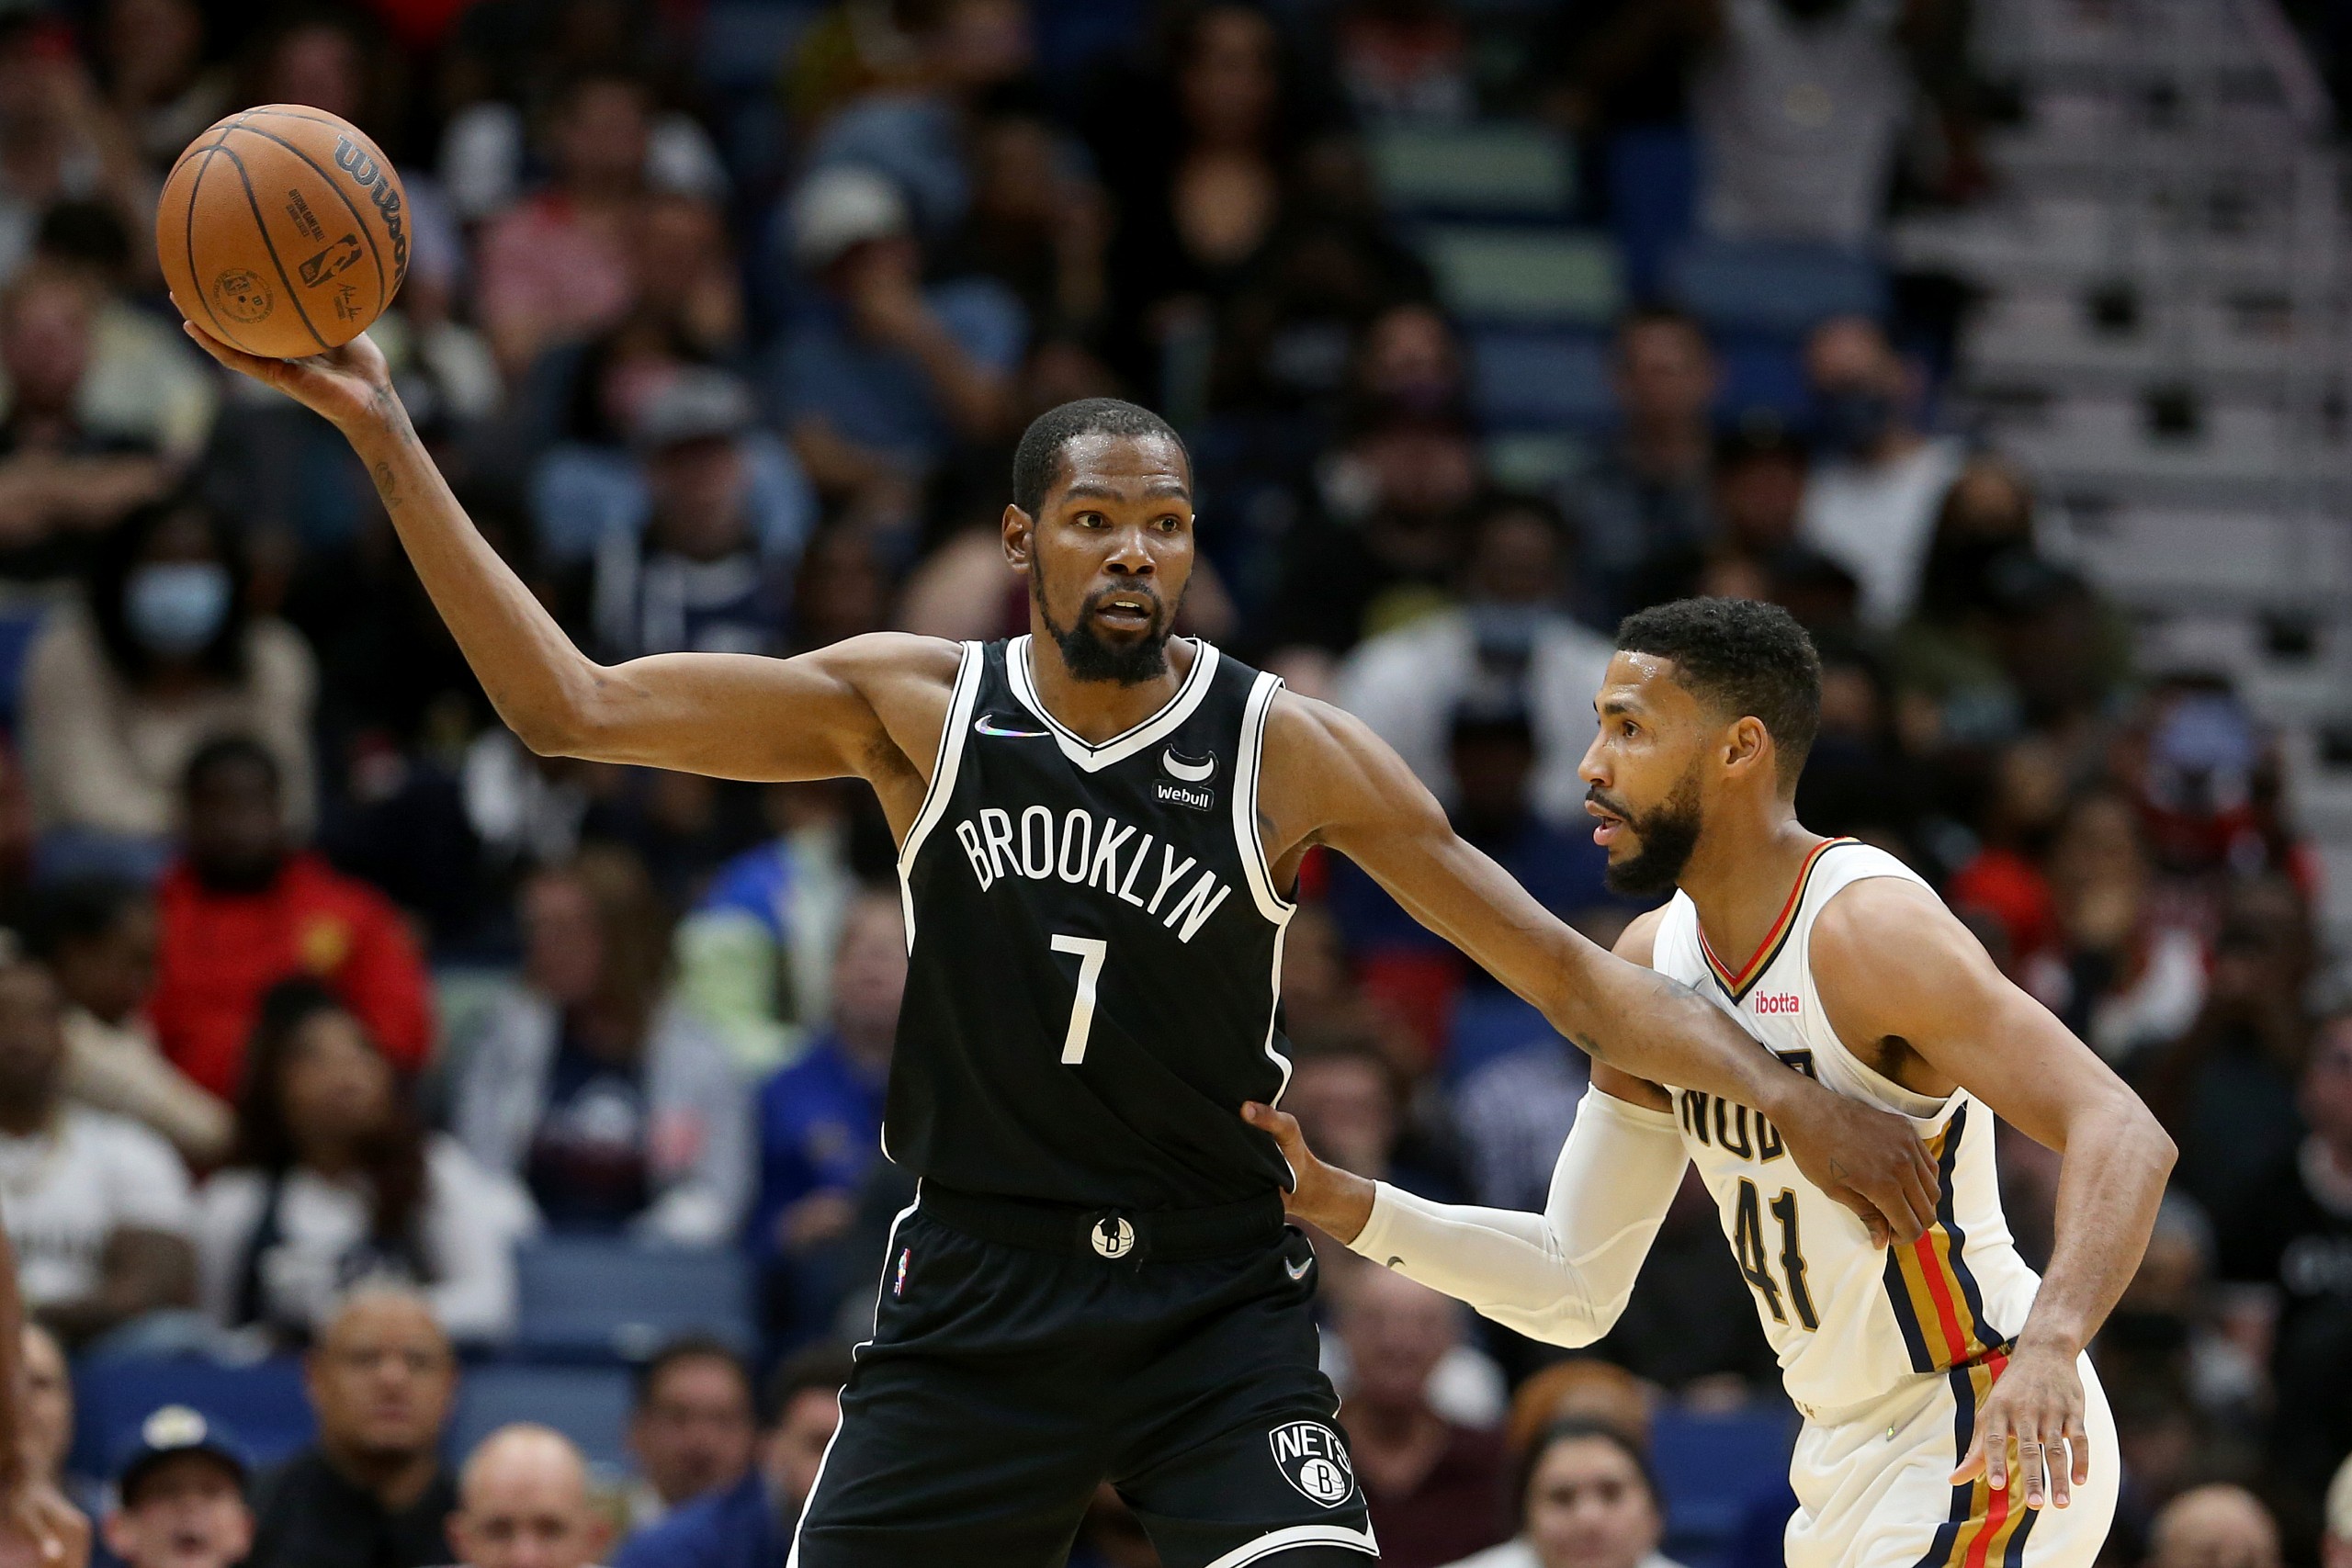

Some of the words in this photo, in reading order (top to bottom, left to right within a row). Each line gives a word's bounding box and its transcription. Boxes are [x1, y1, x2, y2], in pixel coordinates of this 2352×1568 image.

[288, 188, 309, 214] OFFICIAL
[302, 210, 319, 230] GAME
[311, 225, 325, 243] BALL
[1158, 784, 1209, 808] Webull
[956, 805, 1232, 944] BROOKLYN
[1049, 933, 1108, 1065] 7
[1755, 990, 1800, 1014] ibotta
[1733, 1175, 1821, 1334] 41
[1277, 1425, 1351, 1475] NETS
